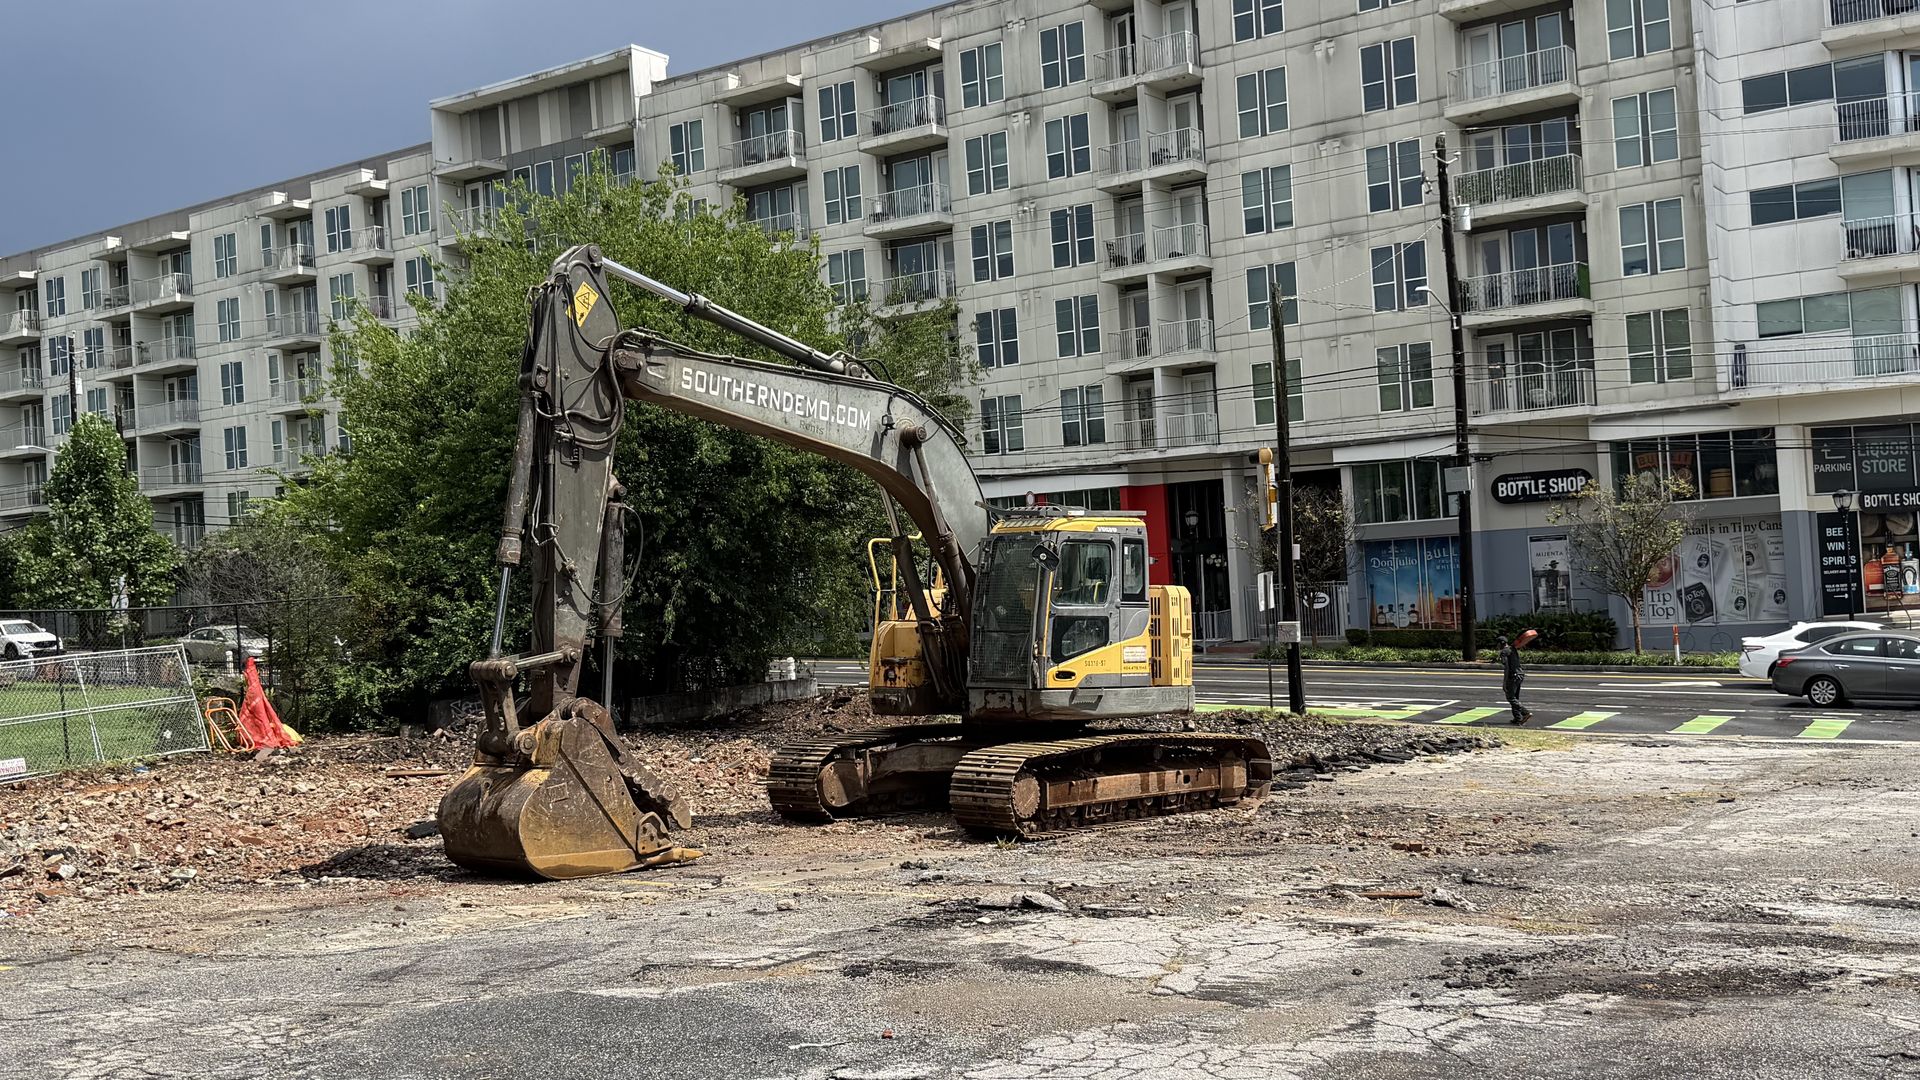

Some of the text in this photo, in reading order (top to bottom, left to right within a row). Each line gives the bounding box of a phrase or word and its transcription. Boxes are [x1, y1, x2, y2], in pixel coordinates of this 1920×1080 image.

[681, 367, 871, 431] SOUTHERNDEMO.COM
[1857, 441, 1909, 458] LIQUOR
[1813, 462, 1852, 473] PARKING
[1861, 458, 1907, 474] STORE
[1497, 476, 1587, 497] BOTTLE SHOP
[1863, 493, 1901, 508] BOTTLE
[1718, 523, 1729, 534] in
[1730, 523, 1757, 534] Tiny
[1825, 527, 1844, 537] BEE
[1826, 541, 1845, 551] WIN
[1822, 555, 1857, 566] SPIRIS
[1648, 589, 1672, 605] Tip
[1648, 603, 1676, 619] Top
